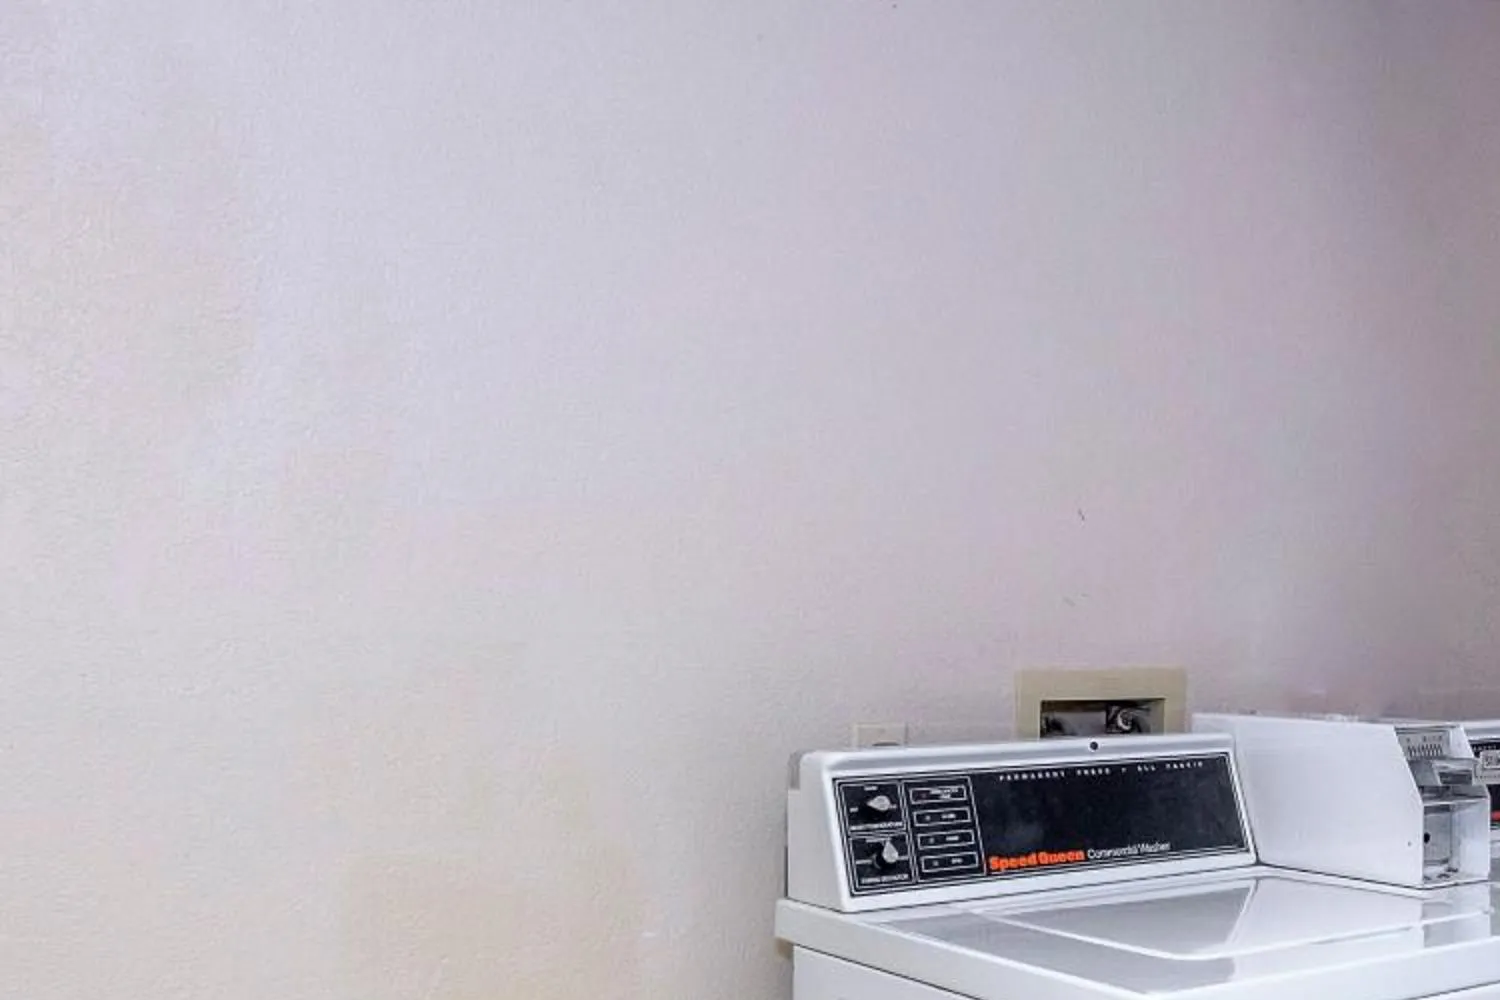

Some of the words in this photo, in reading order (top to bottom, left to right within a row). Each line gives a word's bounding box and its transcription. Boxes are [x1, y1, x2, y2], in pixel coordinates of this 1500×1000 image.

[989, 853, 1037, 871] Speed
[1038, 850, 1085, 865] Queen
[1087, 846, 1138, 859] Commercial
[1138, 842, 1170, 854] Washer
